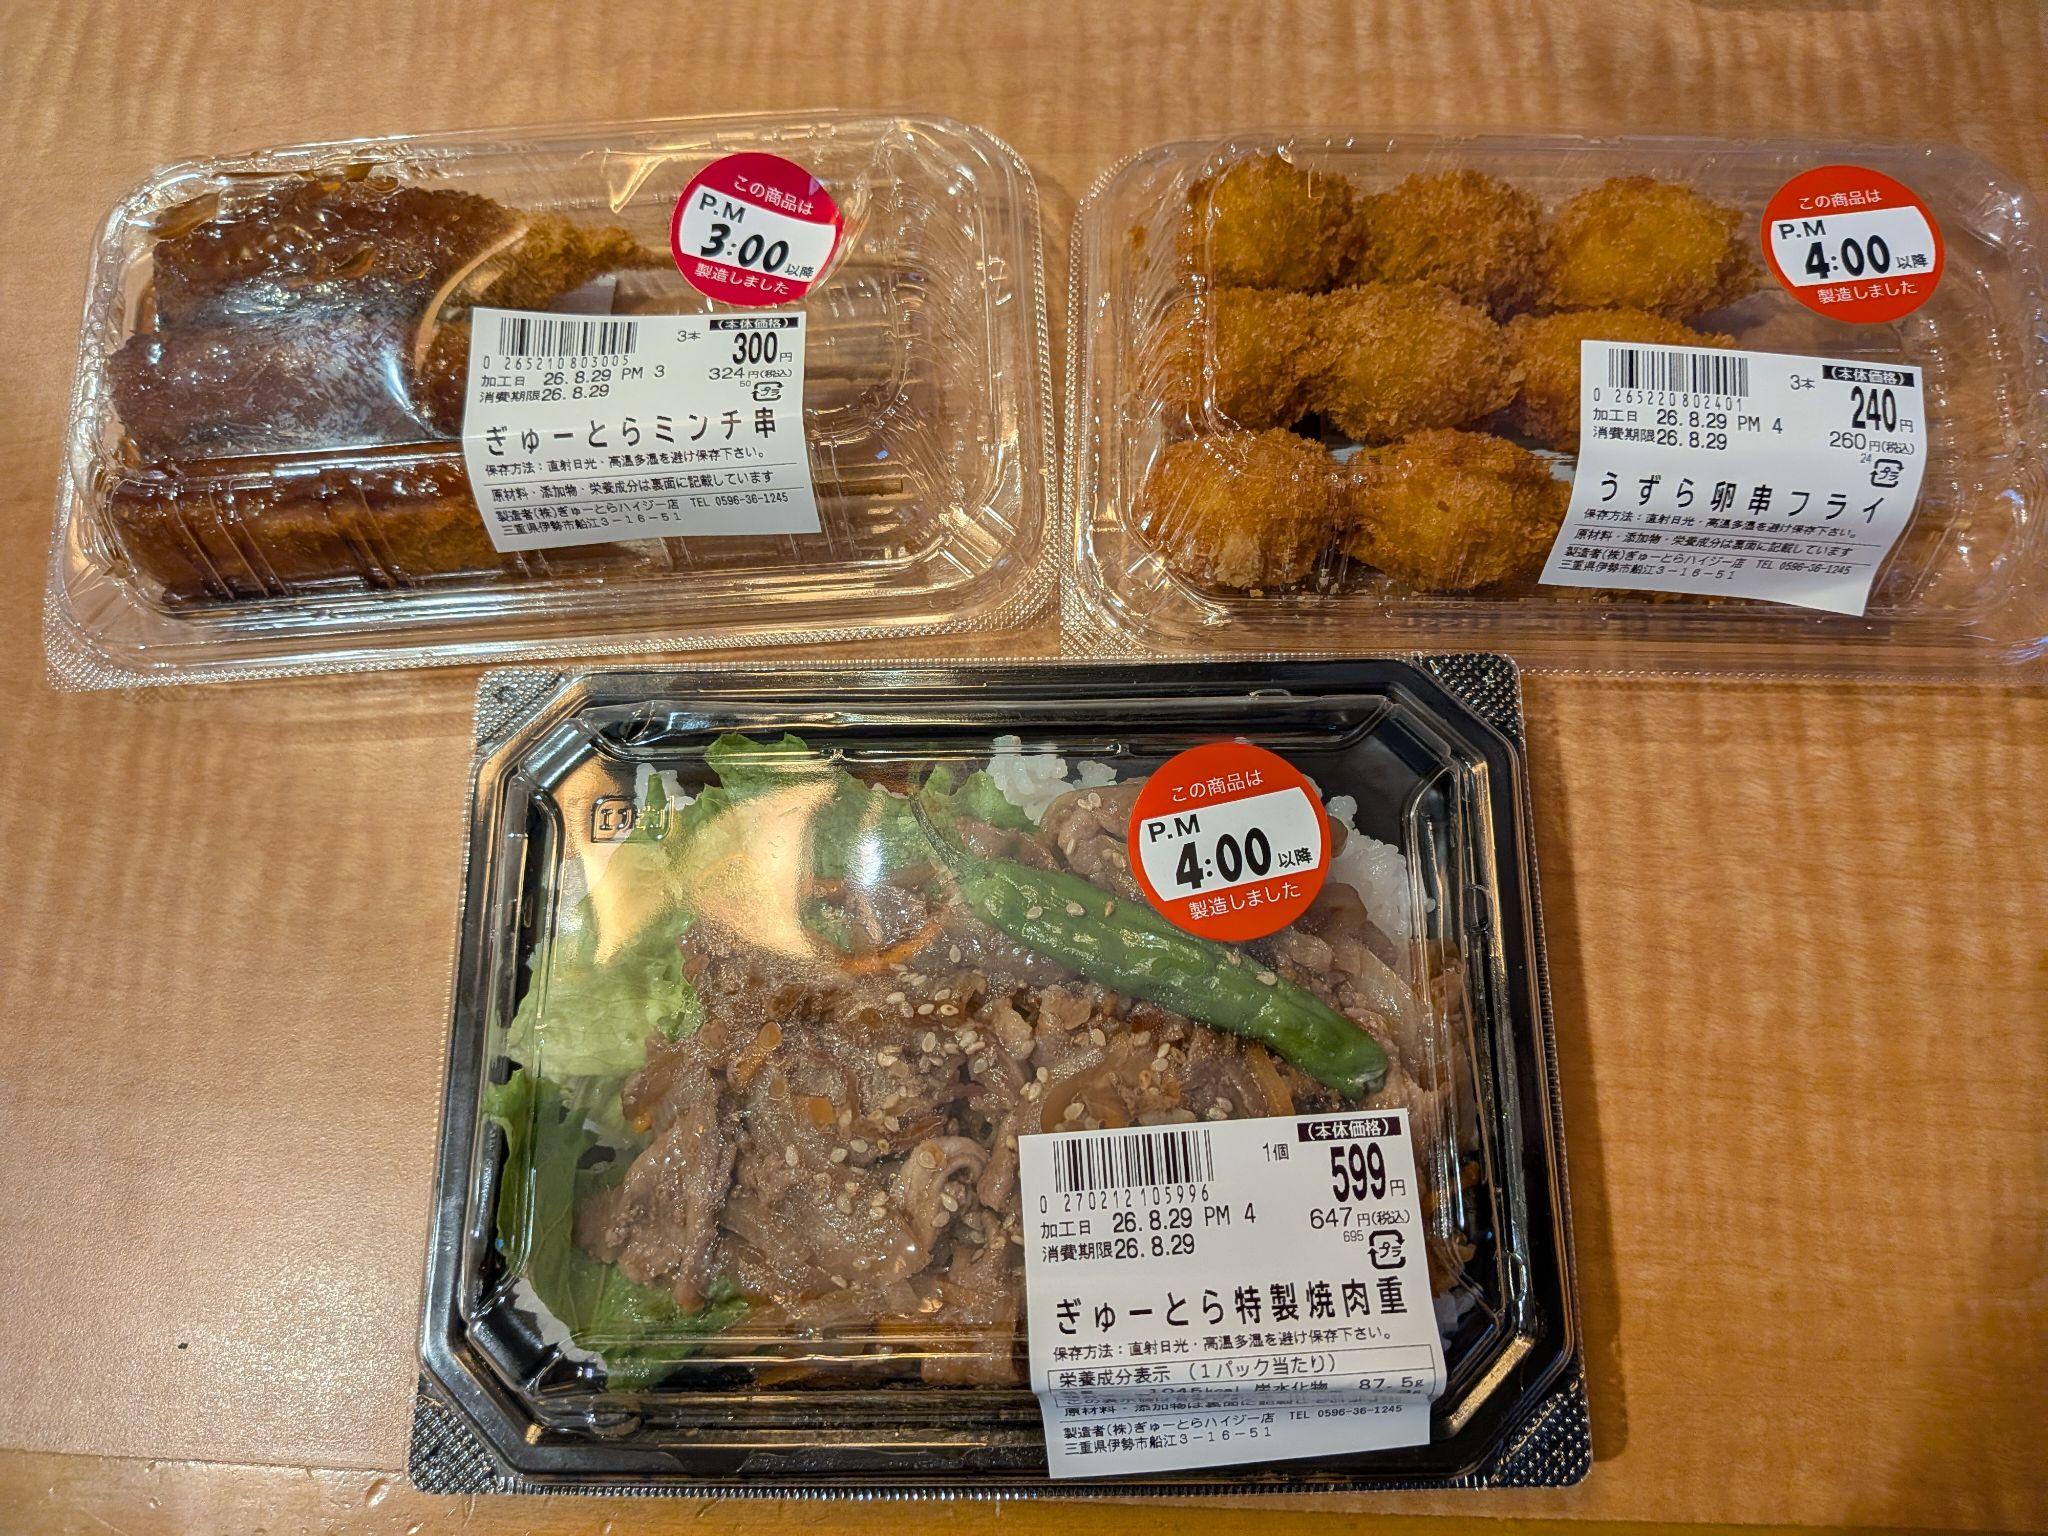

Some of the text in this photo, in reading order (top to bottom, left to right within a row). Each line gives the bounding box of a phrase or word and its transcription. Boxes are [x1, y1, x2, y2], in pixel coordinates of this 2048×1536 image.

[734, 174, 814, 216] この商品は
[1799, 189, 1882, 210] この商品は
[699, 193, 746, 223] P.M
[1778, 220, 1827, 240] P.M
[701, 223, 815, 278] 3:00 以降
[1805, 235, 1929, 279] 4:00 以降
[694, 263, 789, 295] 製造しました
[1817, 280, 1918, 305] 製造しました
[677, 330, 701, 342] 3本
[718, 318, 788, 330] (本体価格)
[481, 375, 525, 388] 加工日
[622, 367, 643, 380] PM
[654, 365, 665, 378] 3
[1790, 375, 1815, 390] 3本
[1831, 366, 1904, 385] (本体価格)
[485, 407, 776, 457] ぎゅーとらミンチ串
[1593, 408, 1637, 422] 加工日
[1738, 416, 1760, 432] PM
[1772, 418, 1783, 434] 4
[690, 498, 710, 507] TEL
[716, 492, 789, 506] 0596-36-1245
[1600, 471, 1886, 524] うずら卵串フライ
[1756, 560, 1772, 569] TEL
[1171, 769, 1264, 802] この商品は
[1147, 813, 1201, 843] P.M
[1176, 827, 1313, 889] 4:00 以降
[1188, 882, 1301, 920] 製造しました
[1308, 1119, 1389, 1140] (本体価格)
[1262, 1142, 1289, 1162] 1個
[1040, 1220, 1091, 1239] 加工日
[1204, 1205, 1231, 1226] PM
[1244, 1203, 1256, 1224] 4
[1343, 1230, 1364, 1242] 695
[1379, 1242, 1402, 1258] プラ
[1056, 1276, 1407, 1334] ぎゅーとら特製焼肉重
[1059, 1365, 1171, 1388] 栄養成分表示
[1289, 1411, 1310, 1420] TEL
[1318, 1405, 1402, 1418] 0596-36-1245
